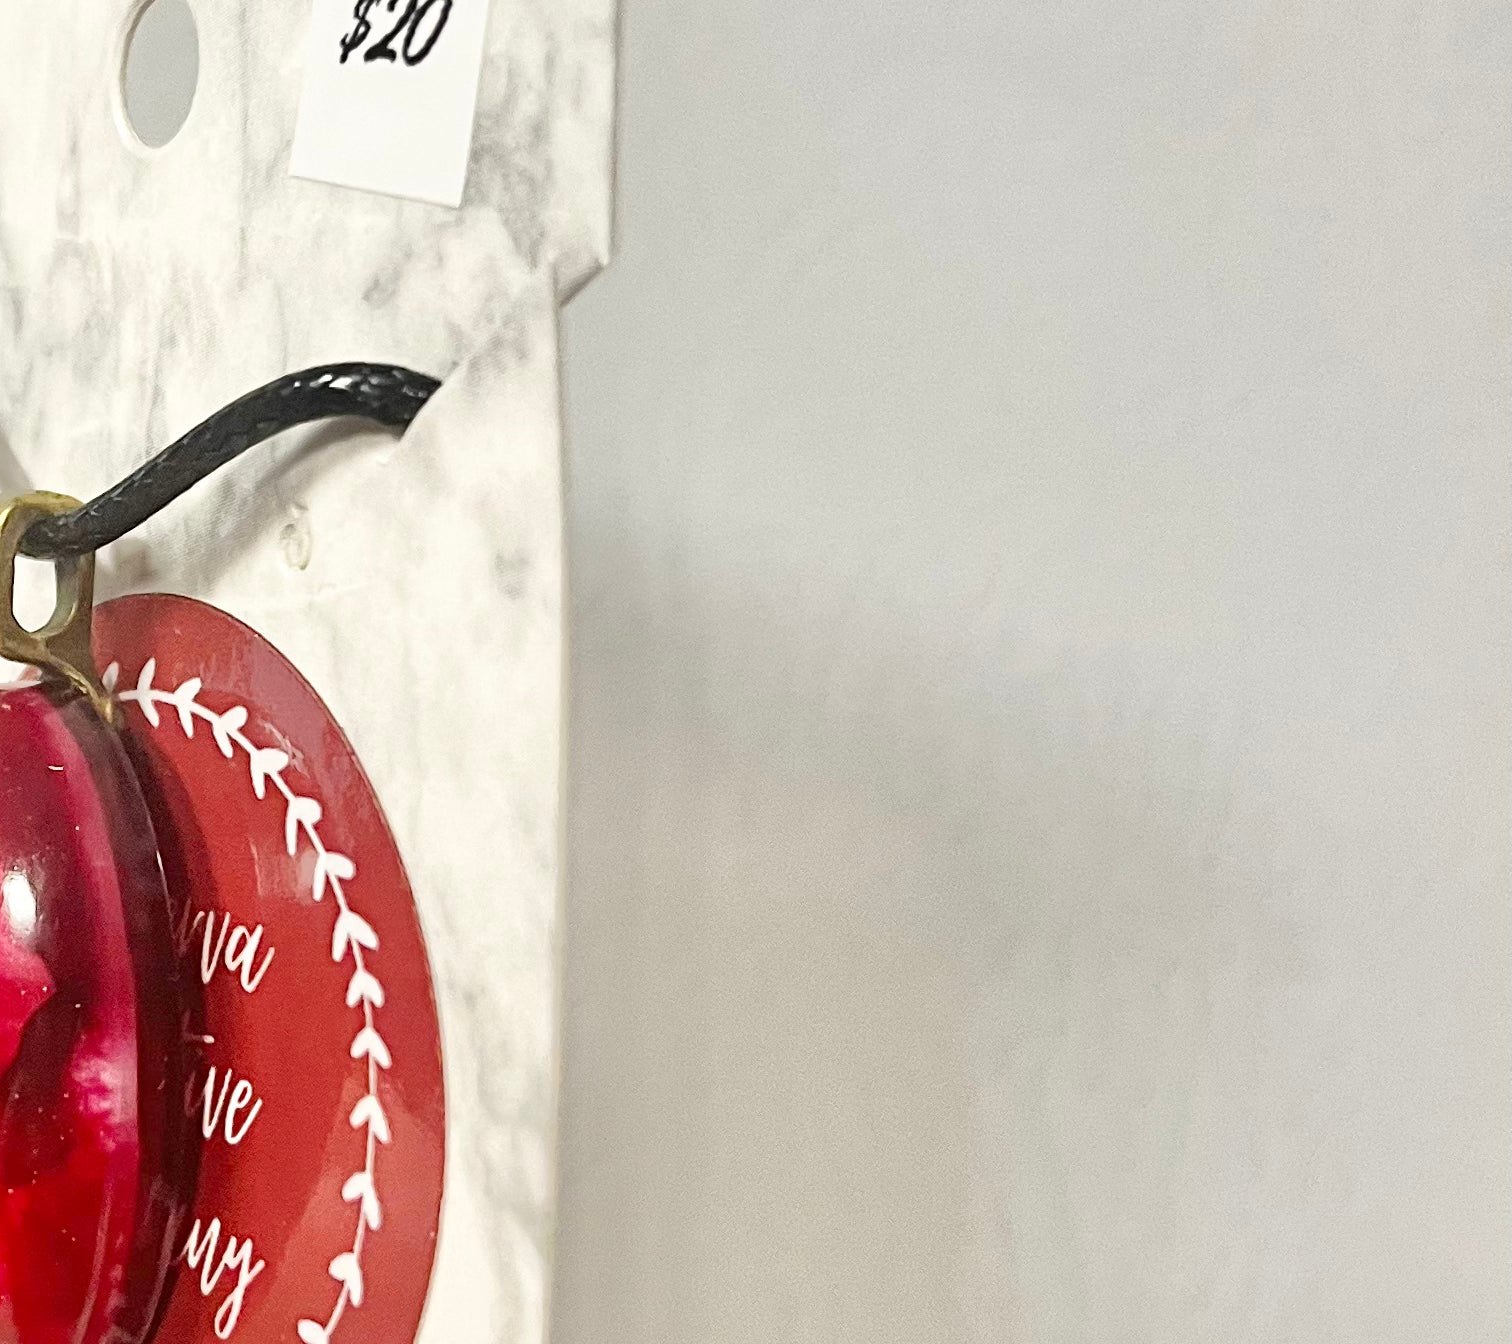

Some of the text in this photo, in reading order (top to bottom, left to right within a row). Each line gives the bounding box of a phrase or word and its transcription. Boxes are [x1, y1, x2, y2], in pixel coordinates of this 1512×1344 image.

[178, 898, 276, 994] rva
[183, 1034, 263, 1145] ive
[180, 1216, 266, 1340] ny
